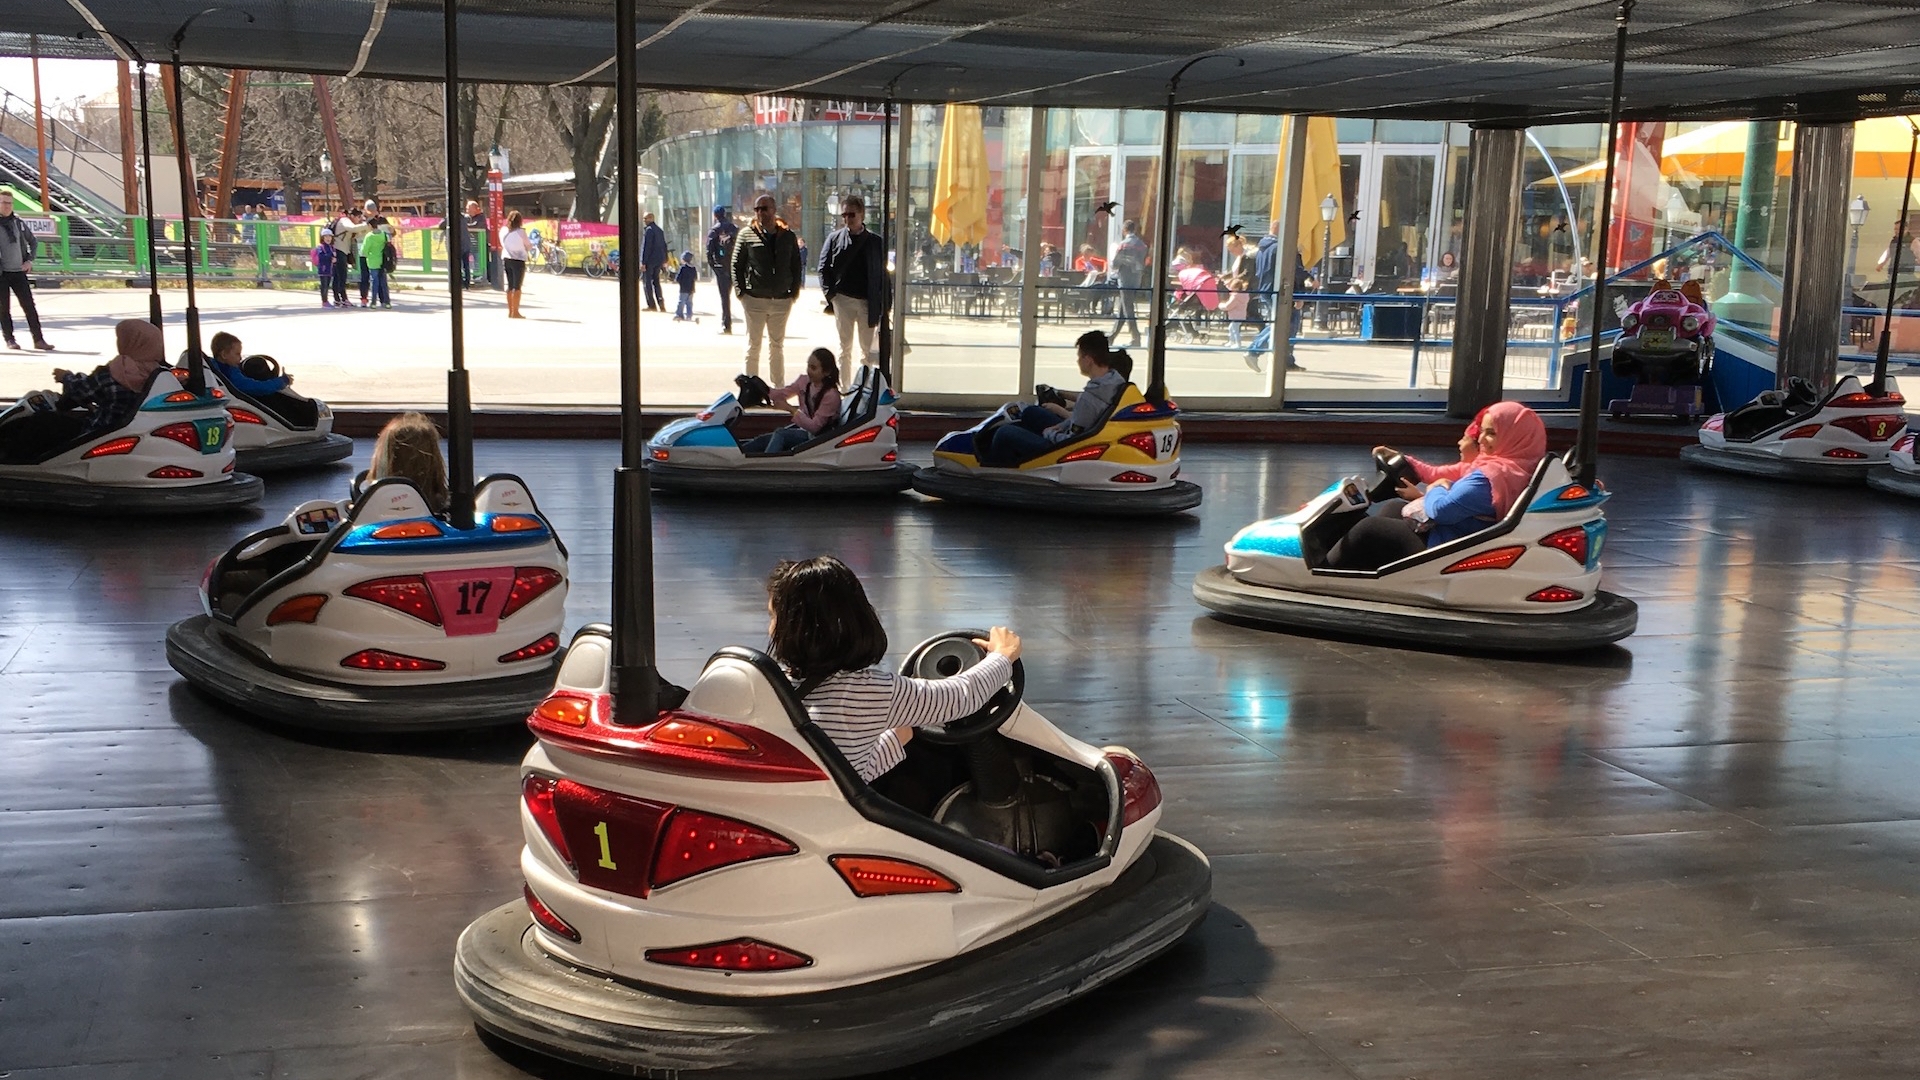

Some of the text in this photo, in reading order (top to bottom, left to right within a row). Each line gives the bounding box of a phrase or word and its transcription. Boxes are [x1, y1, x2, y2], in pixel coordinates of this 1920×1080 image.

[206, 426, 220, 446] 13
[1877, 421, 1887, 437] 3
[1160, 434, 1174, 453] 18
[456, 581, 492, 615] 17
[593, 821, 617, 870] 1
